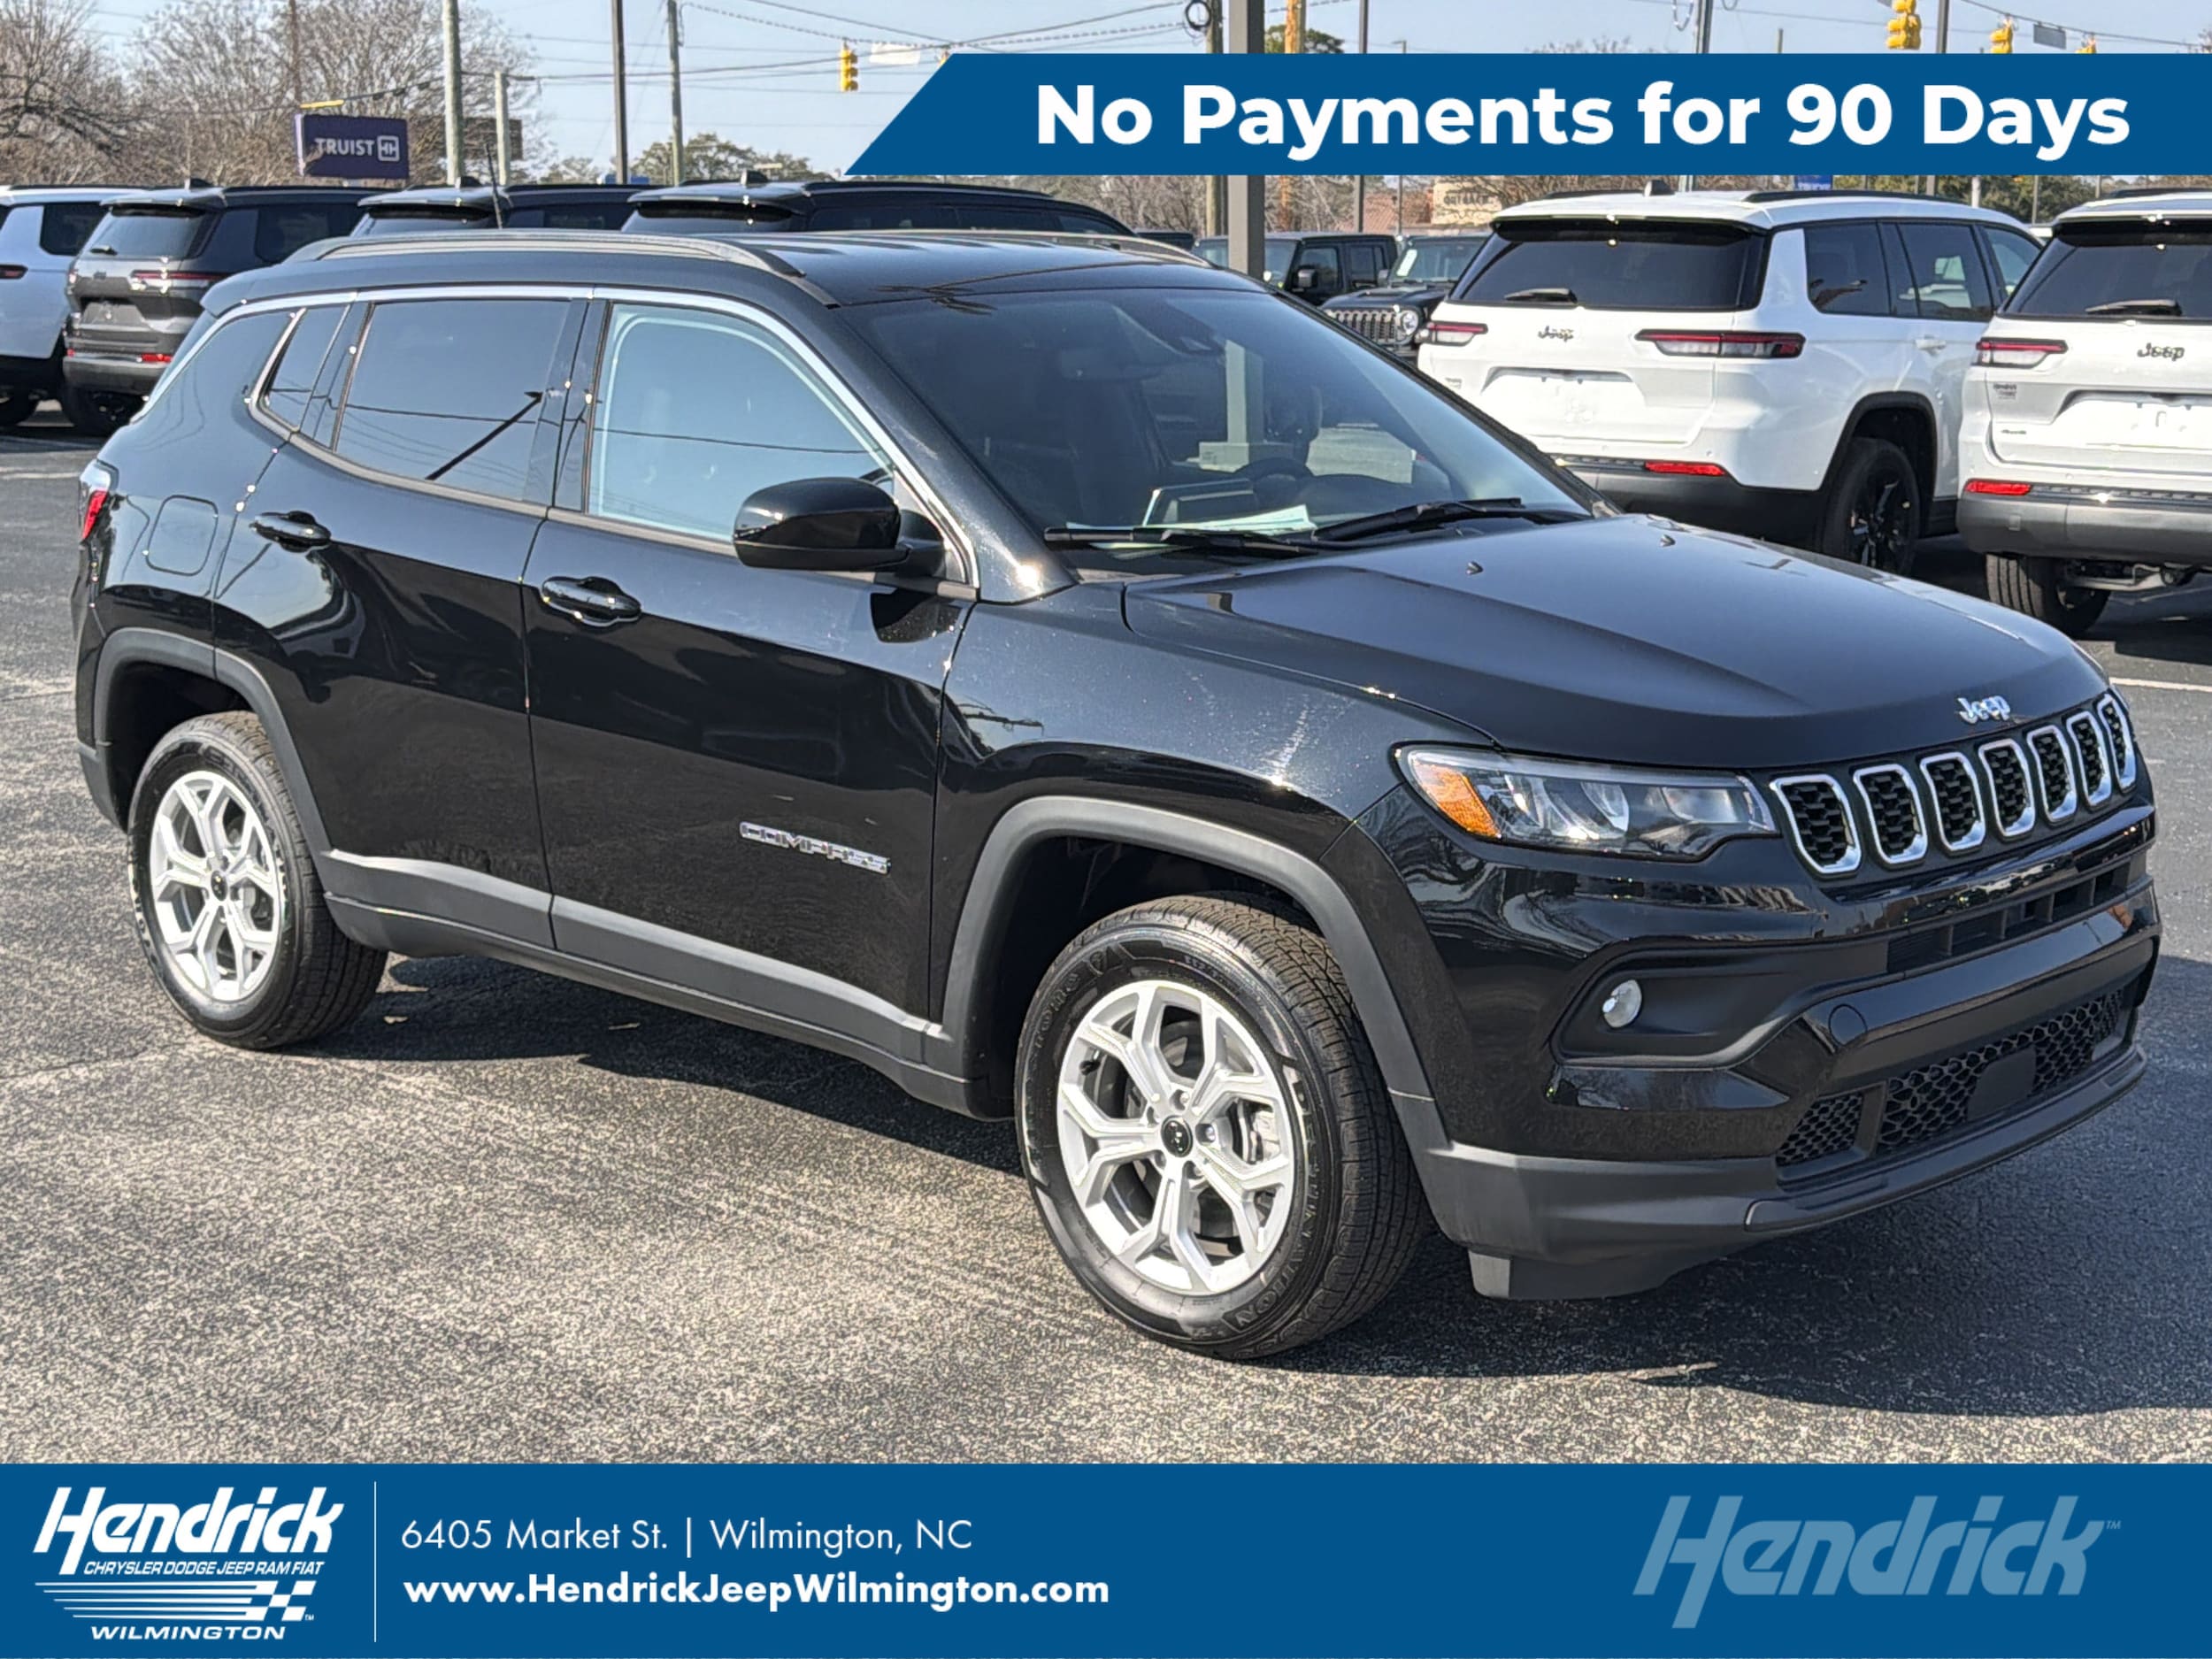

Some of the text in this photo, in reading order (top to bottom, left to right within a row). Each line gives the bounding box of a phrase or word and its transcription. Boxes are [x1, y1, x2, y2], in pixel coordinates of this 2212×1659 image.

[314, 136, 375, 156] TRUIST
[2137, 342, 2185, 362] Jeep
[1956, 695, 2011, 724] Jeep
[740, 821, 890, 875] COMPASS
